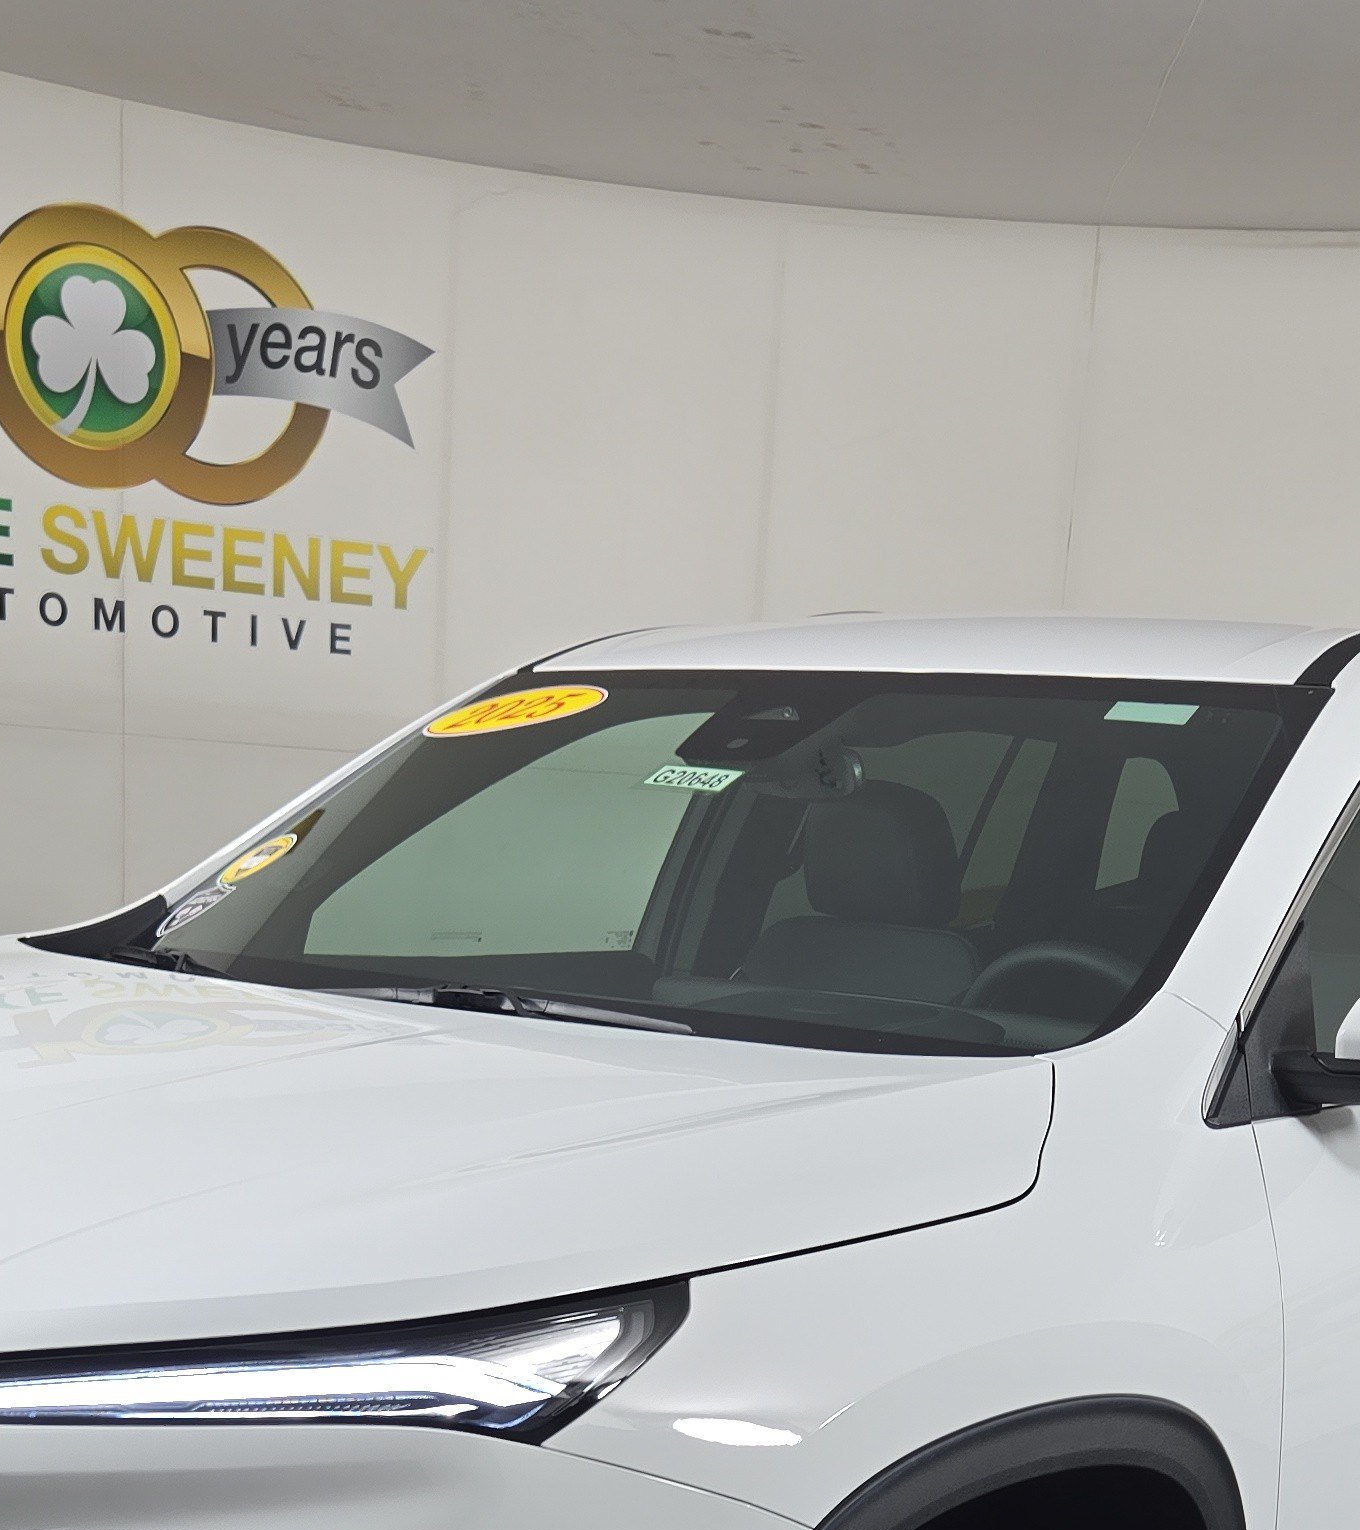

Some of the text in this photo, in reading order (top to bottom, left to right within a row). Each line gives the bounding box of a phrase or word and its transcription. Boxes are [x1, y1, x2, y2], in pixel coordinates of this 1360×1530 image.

[225, 313, 384, 390] years
[40, 504, 428, 611] SWEENEY
[442, 692, 588, 731] 2025
[652, 768, 731, 789] G20648
